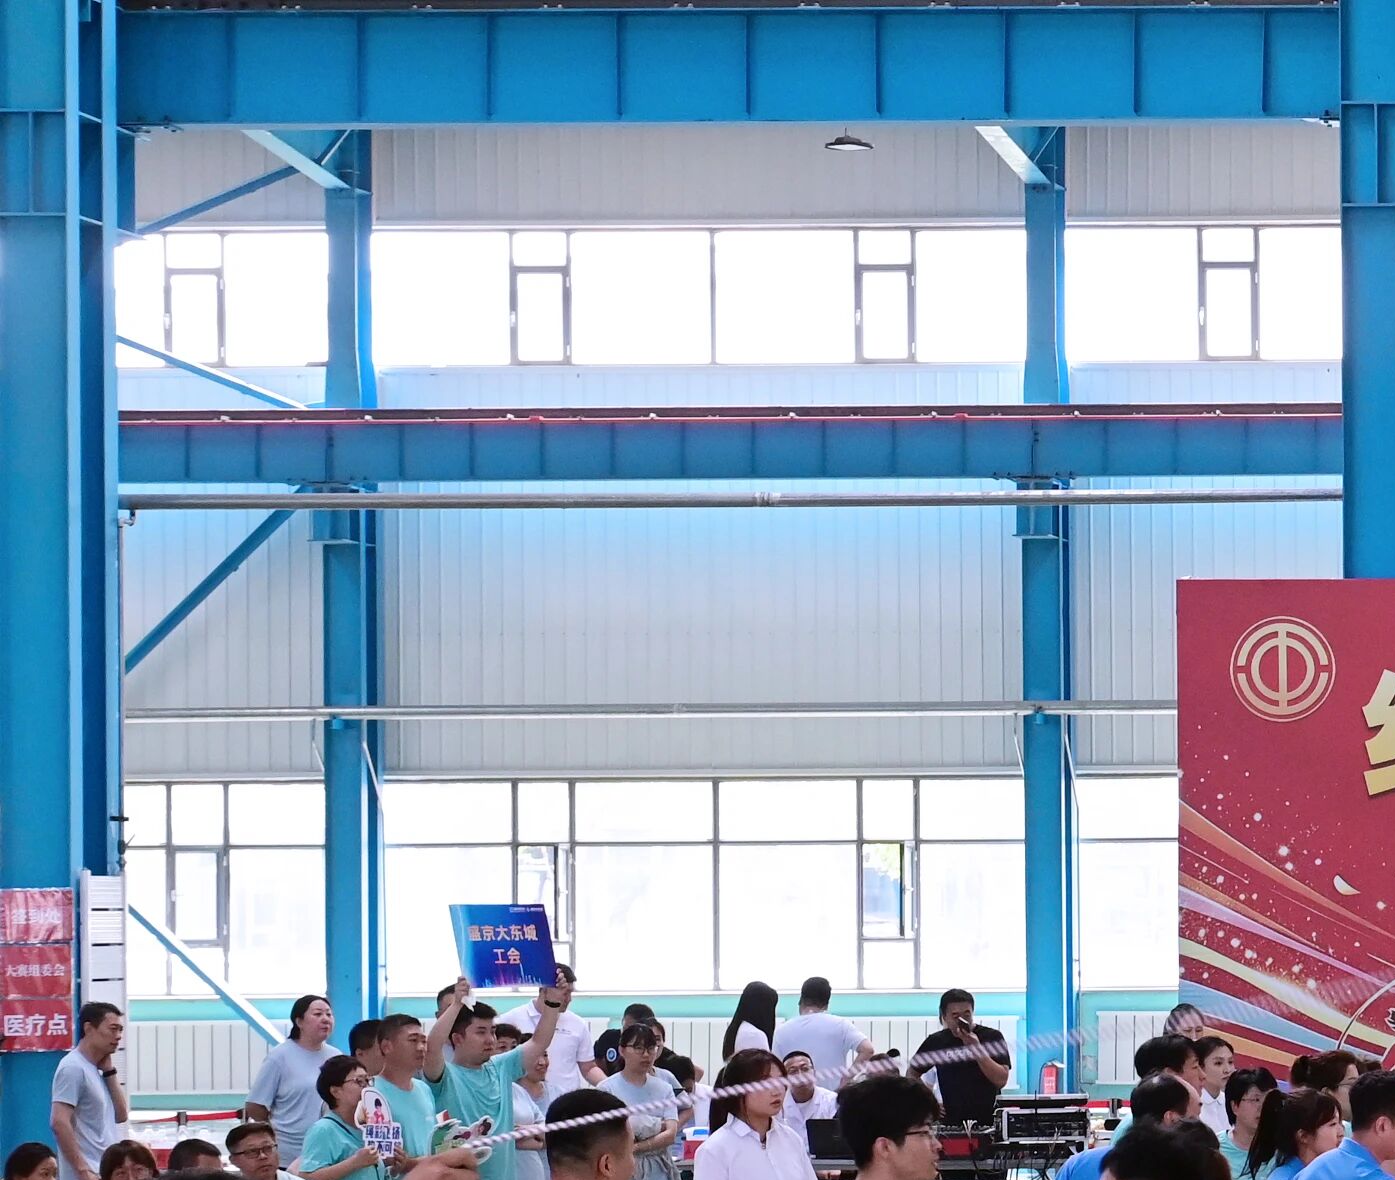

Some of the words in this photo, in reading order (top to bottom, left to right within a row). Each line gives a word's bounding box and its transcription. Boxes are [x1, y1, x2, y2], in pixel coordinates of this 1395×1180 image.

[493, 947, 521, 964] 工会
[3, 1013, 69, 1037] 医疗点
